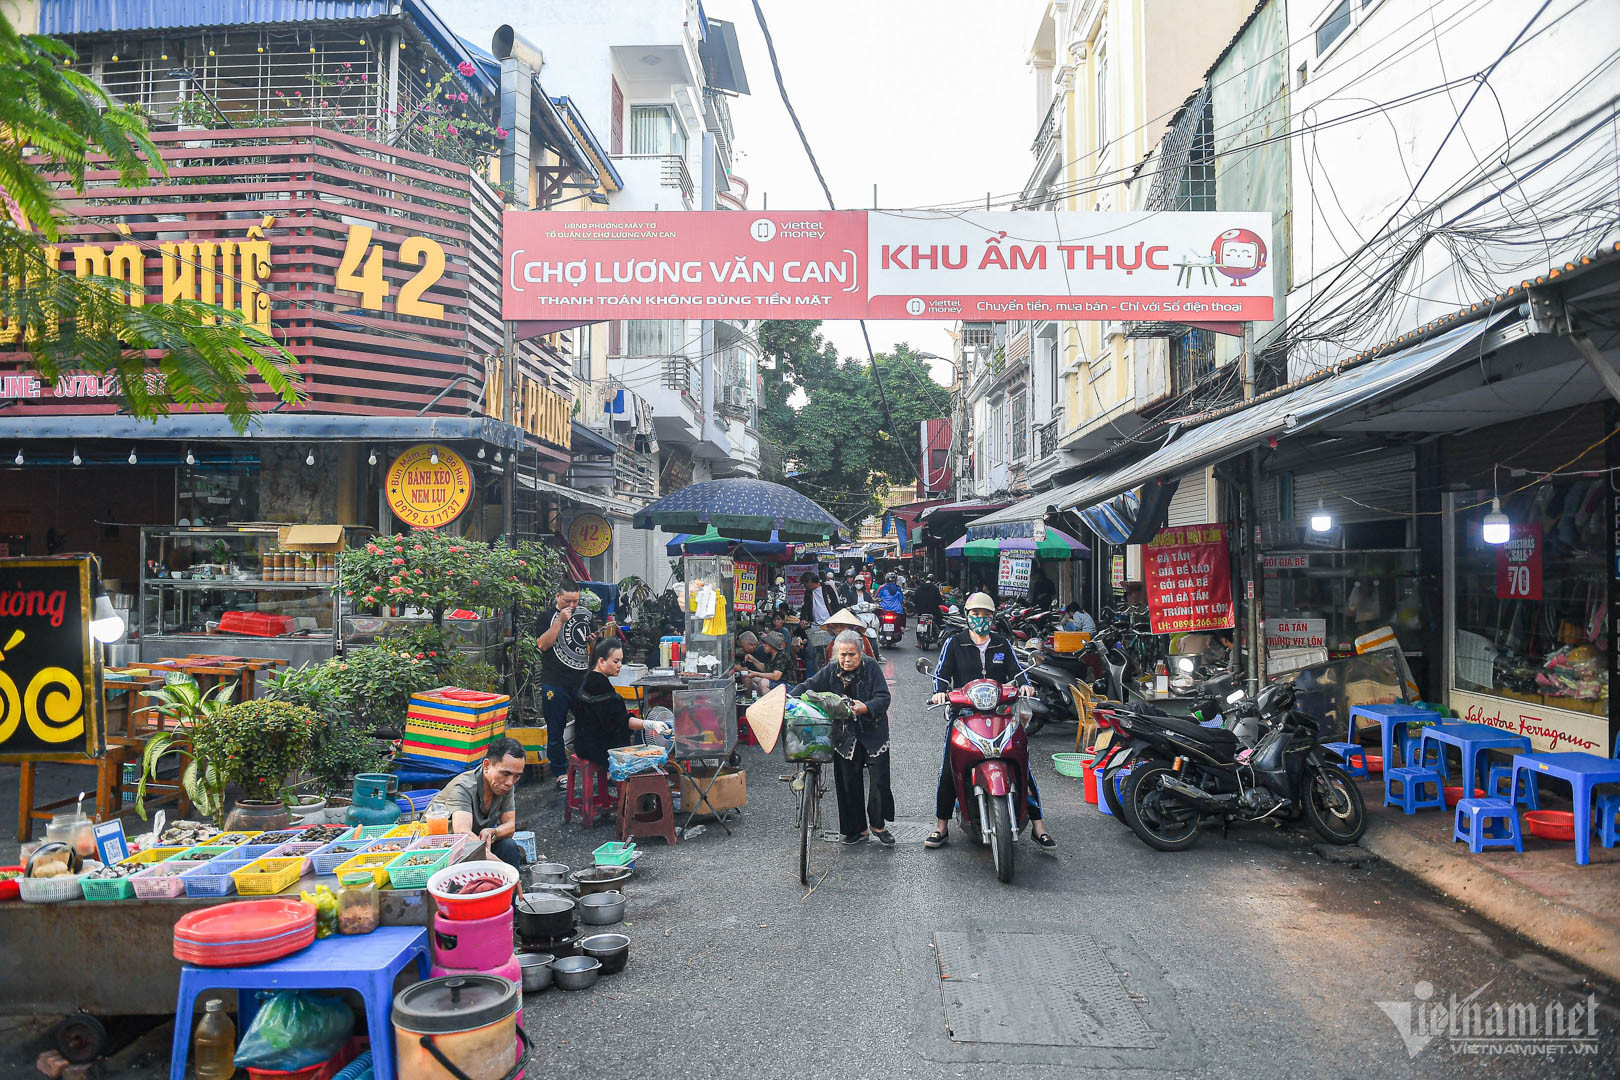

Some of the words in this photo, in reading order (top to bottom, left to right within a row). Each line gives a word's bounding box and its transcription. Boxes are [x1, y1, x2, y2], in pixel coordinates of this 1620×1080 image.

[780, 220, 823, 230] viettel
[780, 229, 826, 240] money
[881, 245, 968, 270] KHU
[978, 231, 1047, 270] ẨM
[1057, 242, 1169, 275] THỰC
[336, 223, 446, 320] 42
[523, 257, 588, 288] CHỢ
[595, 257, 702, 284] LƯƠNG
[708, 255, 775, 284] VĂN
[783, 261, 847, 284] CAN
[538, 295, 594, 305] THANH
[597, 294, 642, 305] TOÁN
[645, 293, 704, 305] KHÔNG
[706, 293, 752, 305] DÙNG
[754, 292, 792, 305] TIỀN
[795, 293, 832, 307] MẶT
[928, 299, 961, 307] viettel
[976, 298, 1024, 312] Chuyển
[1026, 299, 1053, 312] tiền,
[1056, 302, 1083, 311] mua
[1085, 301, 1109, 311] bán
[1119, 300, 1140, 311] Chỉ
[1142, 301, 1161, 311] với
[1163, 300, 1181, 311] Số
[1182, 301, 1209, 313] điện
[1211, 301, 1242, 313] thoại
[928, 306, 962, 314] money
[407, 467, 432, 485] BÁNH
[433, 467, 461, 485] XÈO
[411, 489, 430, 503] NEM
[431, 489, 446, 507] LỤI
[394, 499, 460, 525] 0979.611737
[580, 525, 599, 541] 42
[1508, 566, 1530, 596] 70
[1163, 604, 1194, 618] TRỨNG
[1195, 605, 1210, 616] VỊT
[565, 617, 577, 645] VERSACE
[1278, 621, 1290, 632] GÀ
[1465, 705, 1517, 731] Salvatore
[1519, 715, 1600, 750] Ferragamo
